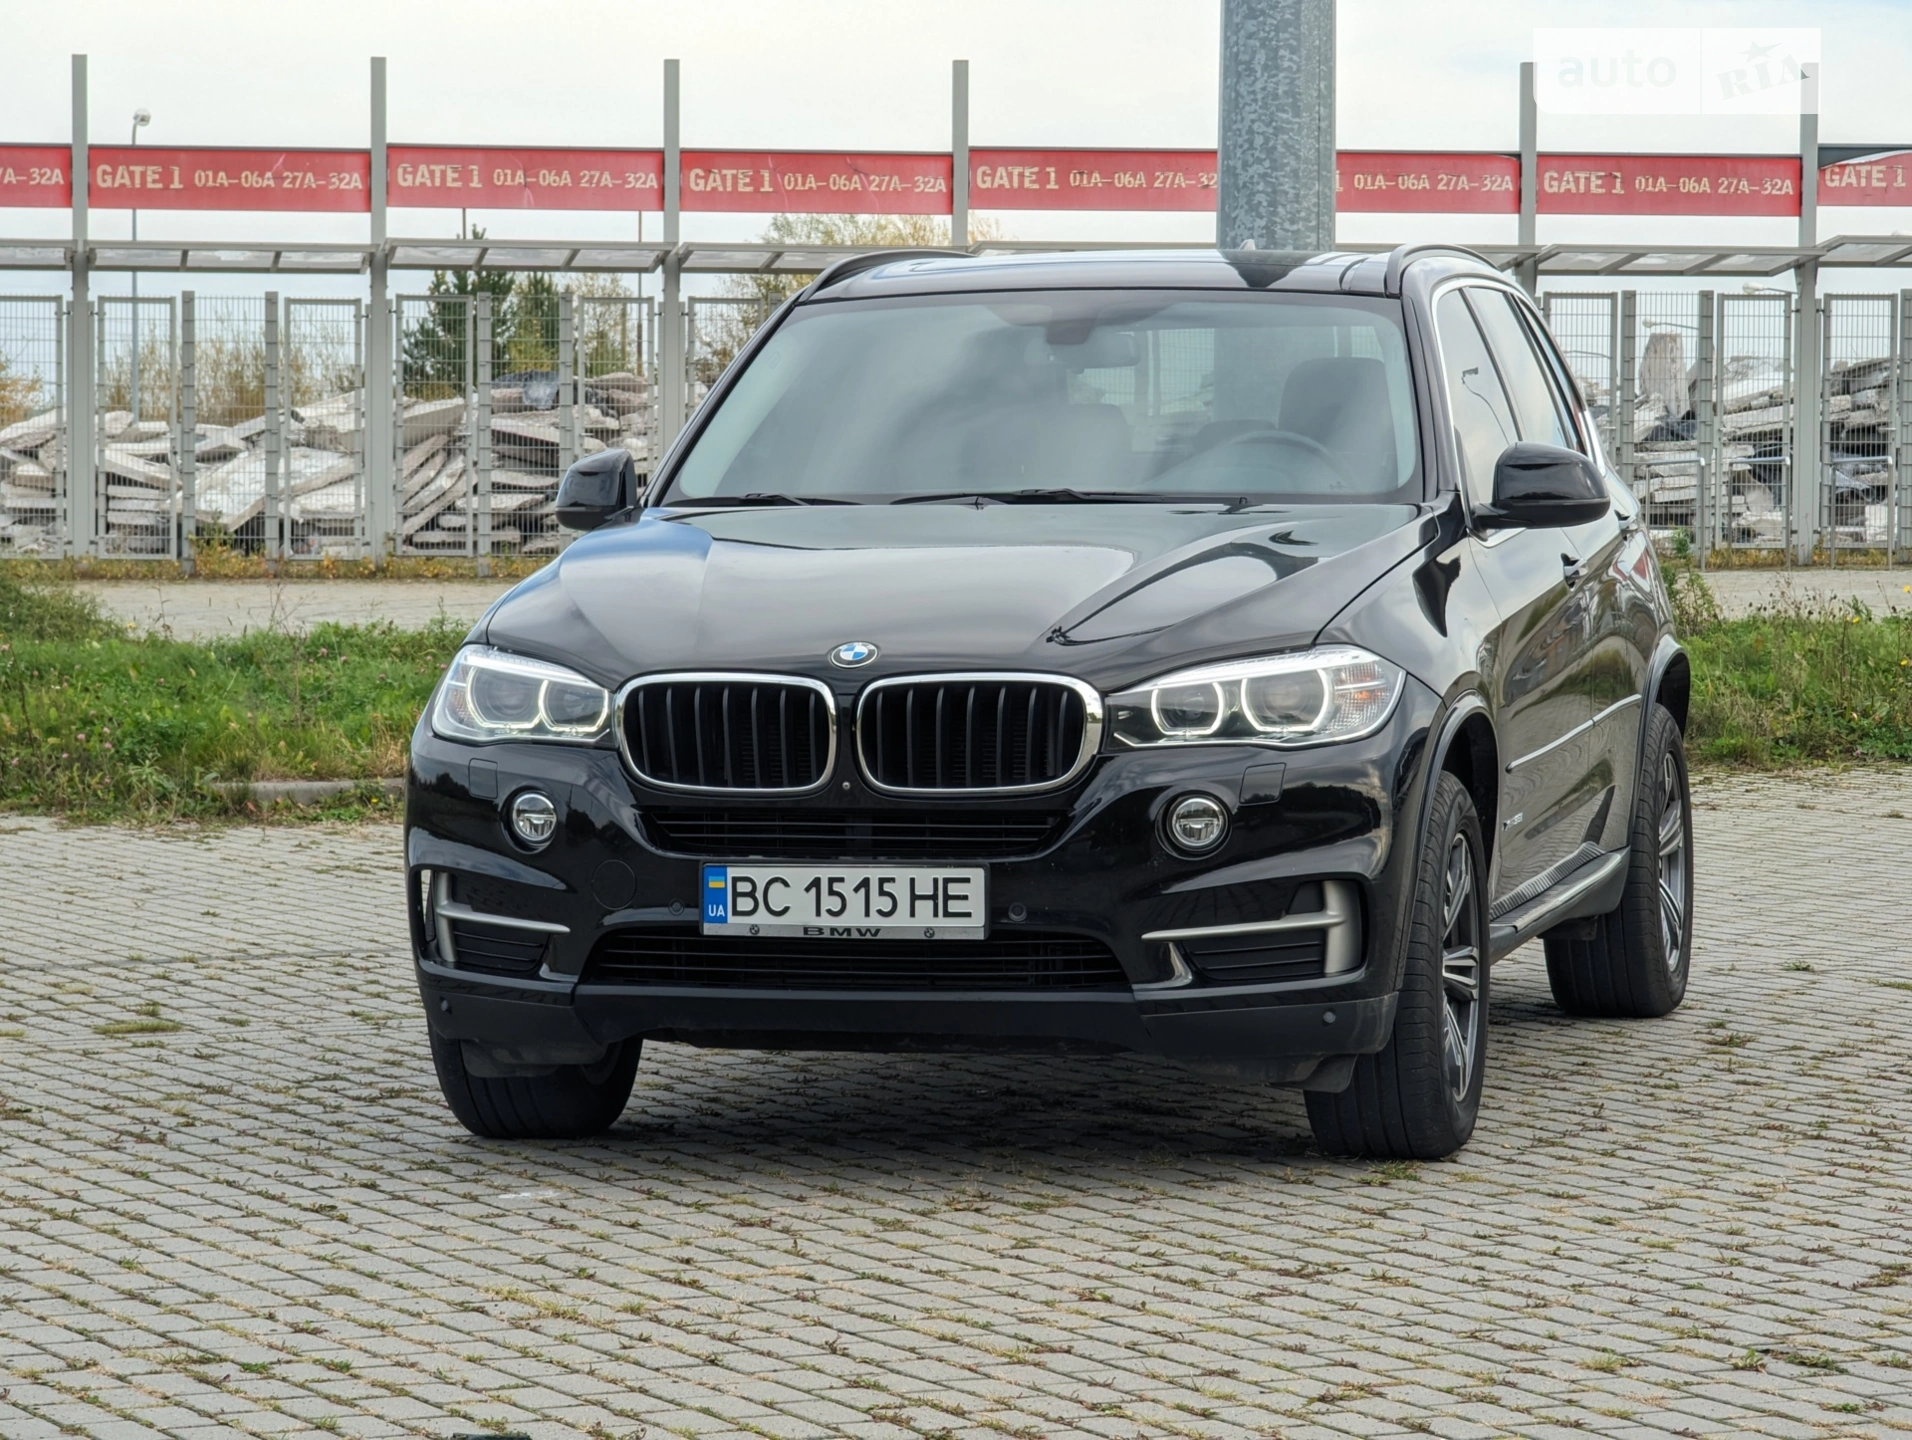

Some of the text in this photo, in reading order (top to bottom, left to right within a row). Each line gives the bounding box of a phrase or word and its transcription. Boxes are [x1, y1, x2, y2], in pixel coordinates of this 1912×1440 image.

[0, 168, 65, 185] A-32A
[96, 164, 363, 190] GATE 1 01A-06A 27A-32A
[397, 164, 658, 189] GATE 1 01A-06A 27A-32A
[689, 168, 947, 193] GATE 1 01A-06A 27A-32A
[976, 166, 1218, 189] GATE 1 01A-06A 27A-32
[1353, 173, 1430, 190] 01A-06A
[1437, 174, 1513, 192] 27A-32A
[1543, 170, 1794, 195] GATE 1 01A-06A 27A-32A
[1824, 165, 1906, 188] GATE 1
[731, 876, 972, 918] BC 1515 HE
[708, 904, 726, 917] UA
[803, 926, 882, 937] BMW
